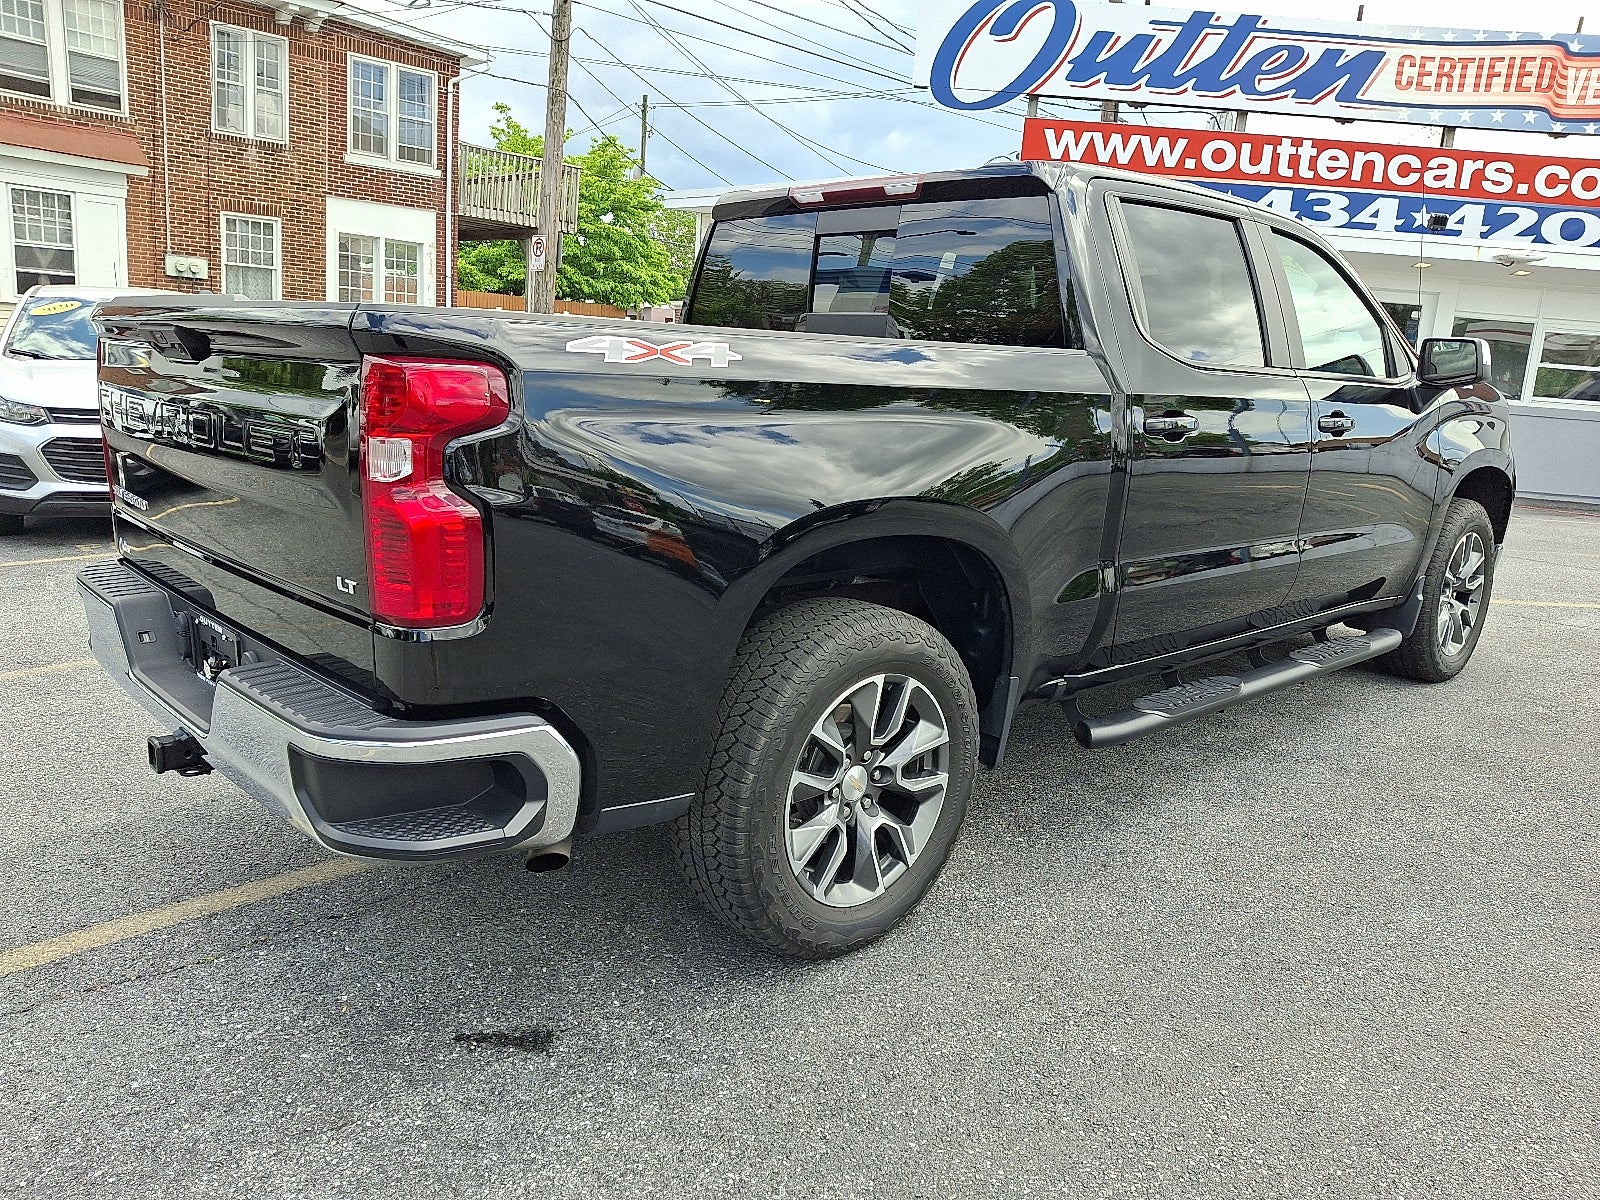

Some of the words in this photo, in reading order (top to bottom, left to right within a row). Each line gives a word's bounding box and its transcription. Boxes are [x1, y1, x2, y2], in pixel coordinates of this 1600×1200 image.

[930, 0, 1389, 110] Outten
[1394, 54, 1559, 93] CERTIFIED
[1044, 128, 1600, 200] www.outtencars.co
[336, 575, 357, 595] LT
